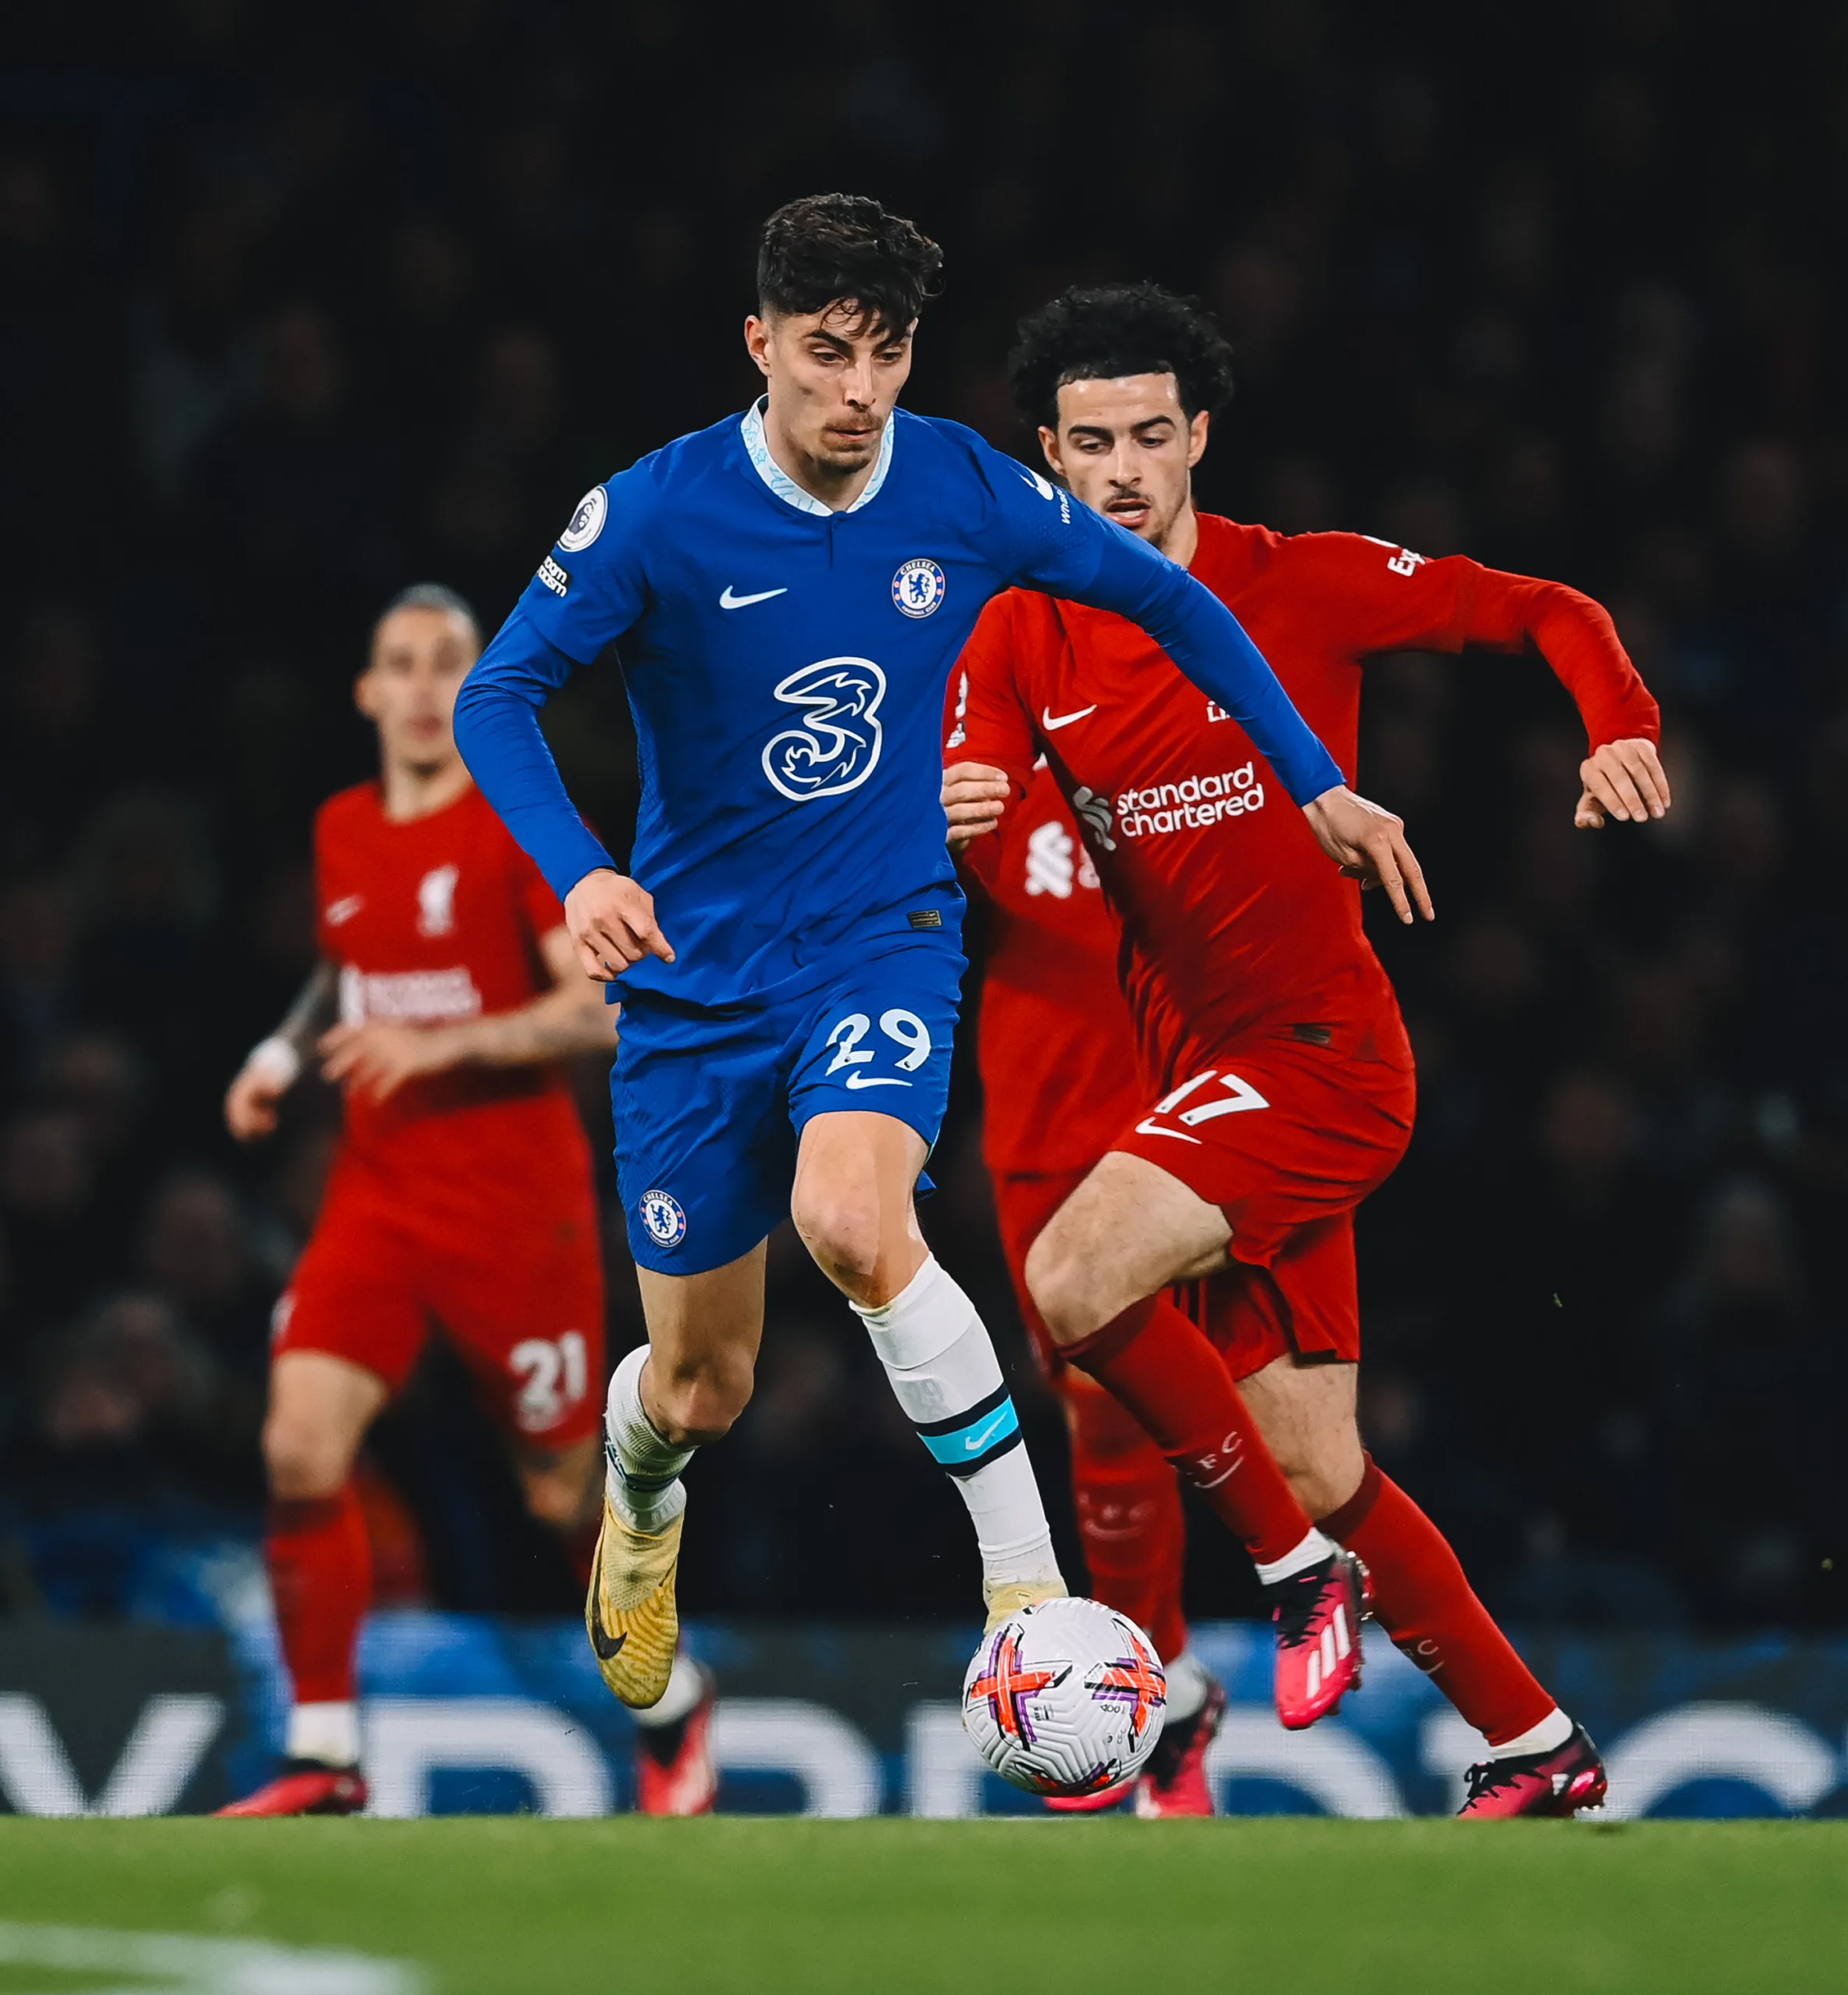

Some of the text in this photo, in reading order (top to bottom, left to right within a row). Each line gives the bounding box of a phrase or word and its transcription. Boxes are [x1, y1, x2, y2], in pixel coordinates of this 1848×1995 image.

[900, 561, 936, 575] CHELSEA
[761, 656, 886, 802] 3
[1117, 761, 1254, 815] standard
[1121, 783, 1264, 837] chartered
[825, 1008, 932, 1077] 29
[1154, 1070, 1270, 1127] 17
[643, 1192, 673, 1206] CHELSEA
[509, 1330, 587, 1409] 21
